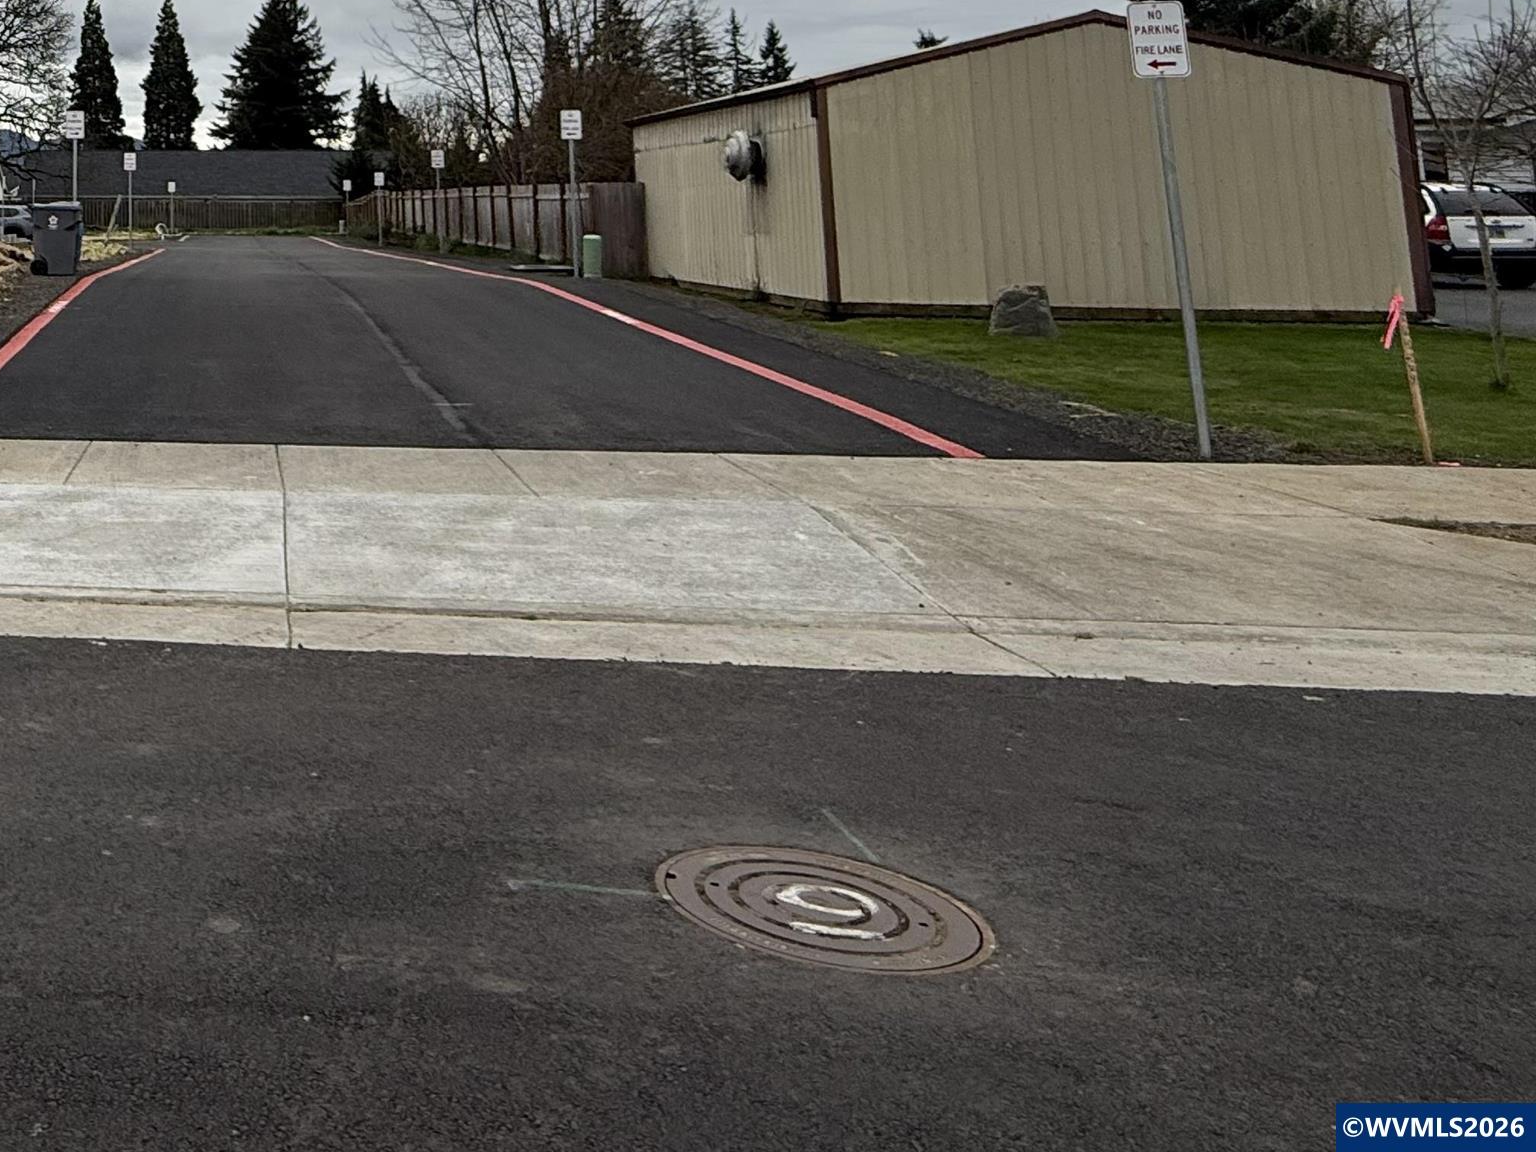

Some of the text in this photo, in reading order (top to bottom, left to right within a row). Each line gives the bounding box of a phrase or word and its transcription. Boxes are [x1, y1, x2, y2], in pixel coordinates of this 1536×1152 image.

[1147, 10, 1163, 20] NO
[1134, 24, 1180, 35] PARKING
[1135, 45, 1183, 55] FIRE LANE
